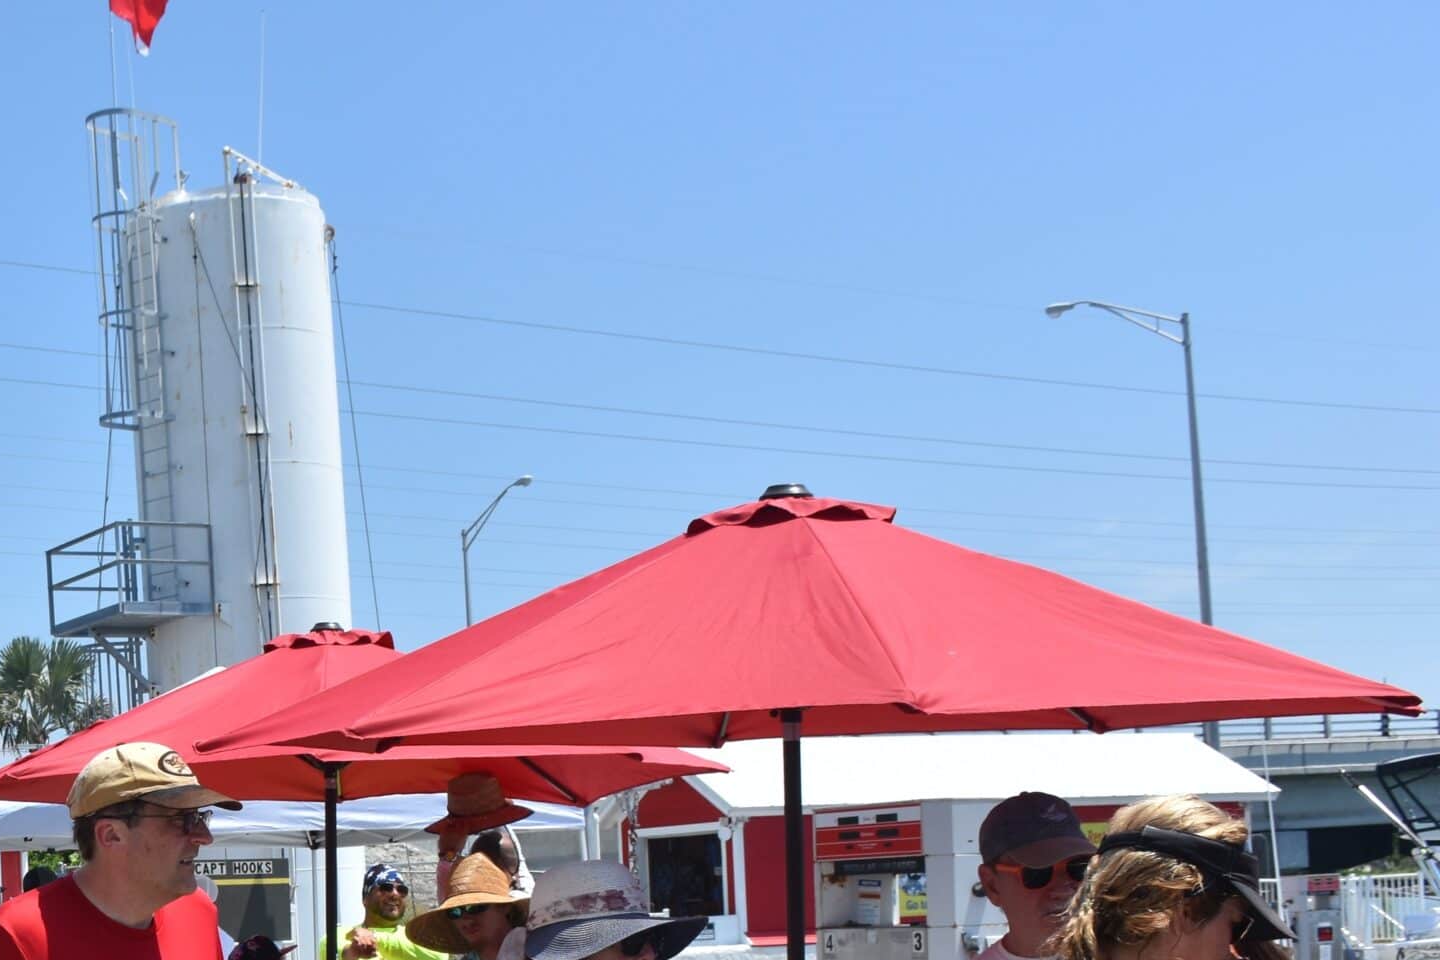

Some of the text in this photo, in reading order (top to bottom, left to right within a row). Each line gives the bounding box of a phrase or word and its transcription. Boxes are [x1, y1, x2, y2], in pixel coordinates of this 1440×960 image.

[195, 862, 272, 874] CAPT HOOKS
[826, 934, 833, 951] 4
[914, 933, 922, 951] 3
